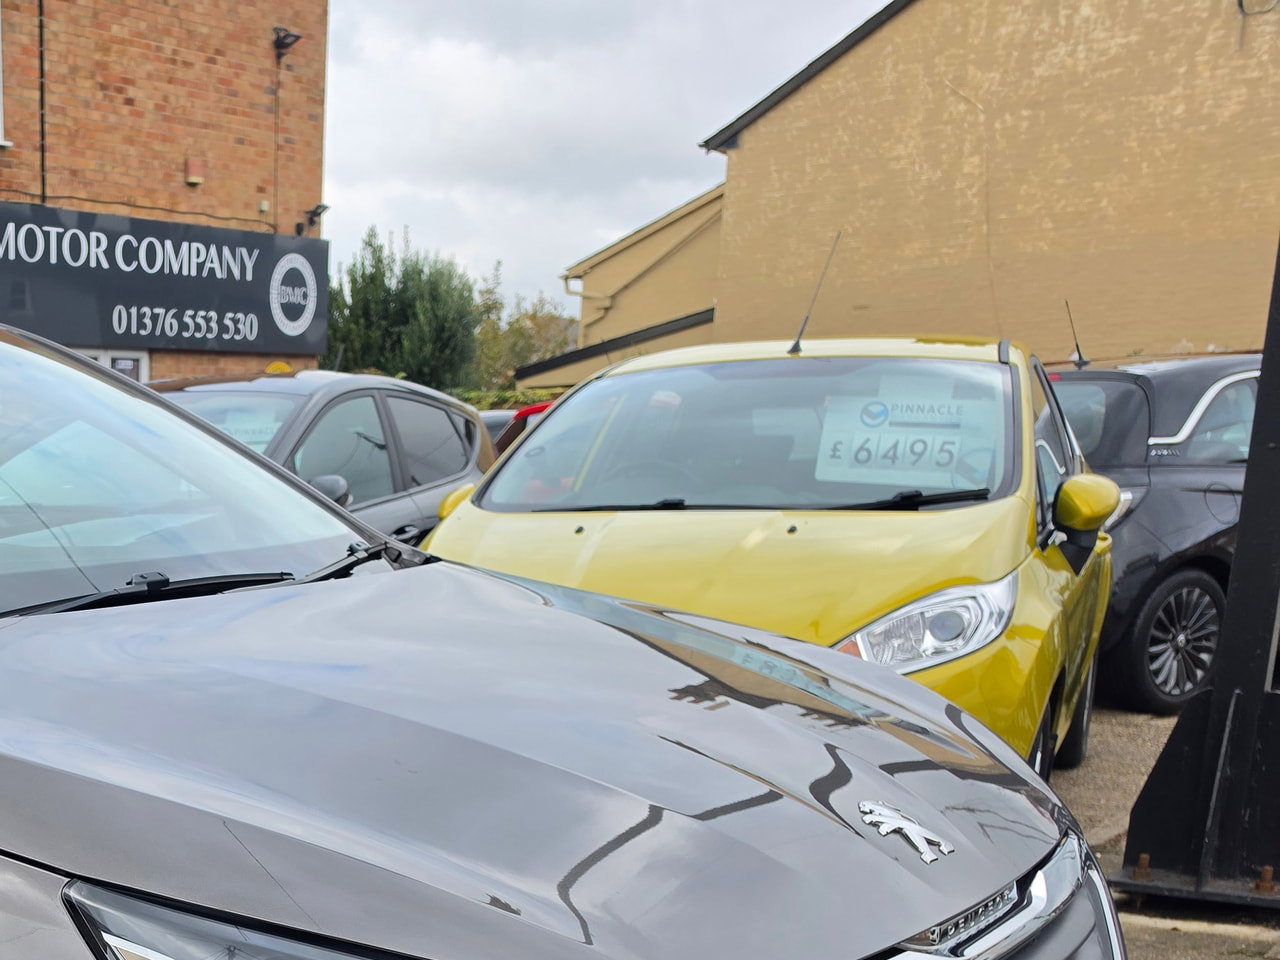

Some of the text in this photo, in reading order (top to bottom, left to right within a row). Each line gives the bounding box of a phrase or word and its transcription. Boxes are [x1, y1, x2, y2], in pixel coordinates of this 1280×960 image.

[114, 234, 260, 282] COMPANY
[112, 304, 179, 337] 01376
[181, 309, 219, 339] 553
[222, 312, 259, 341] 530
[890, 402, 965, 417] PINNACLE
